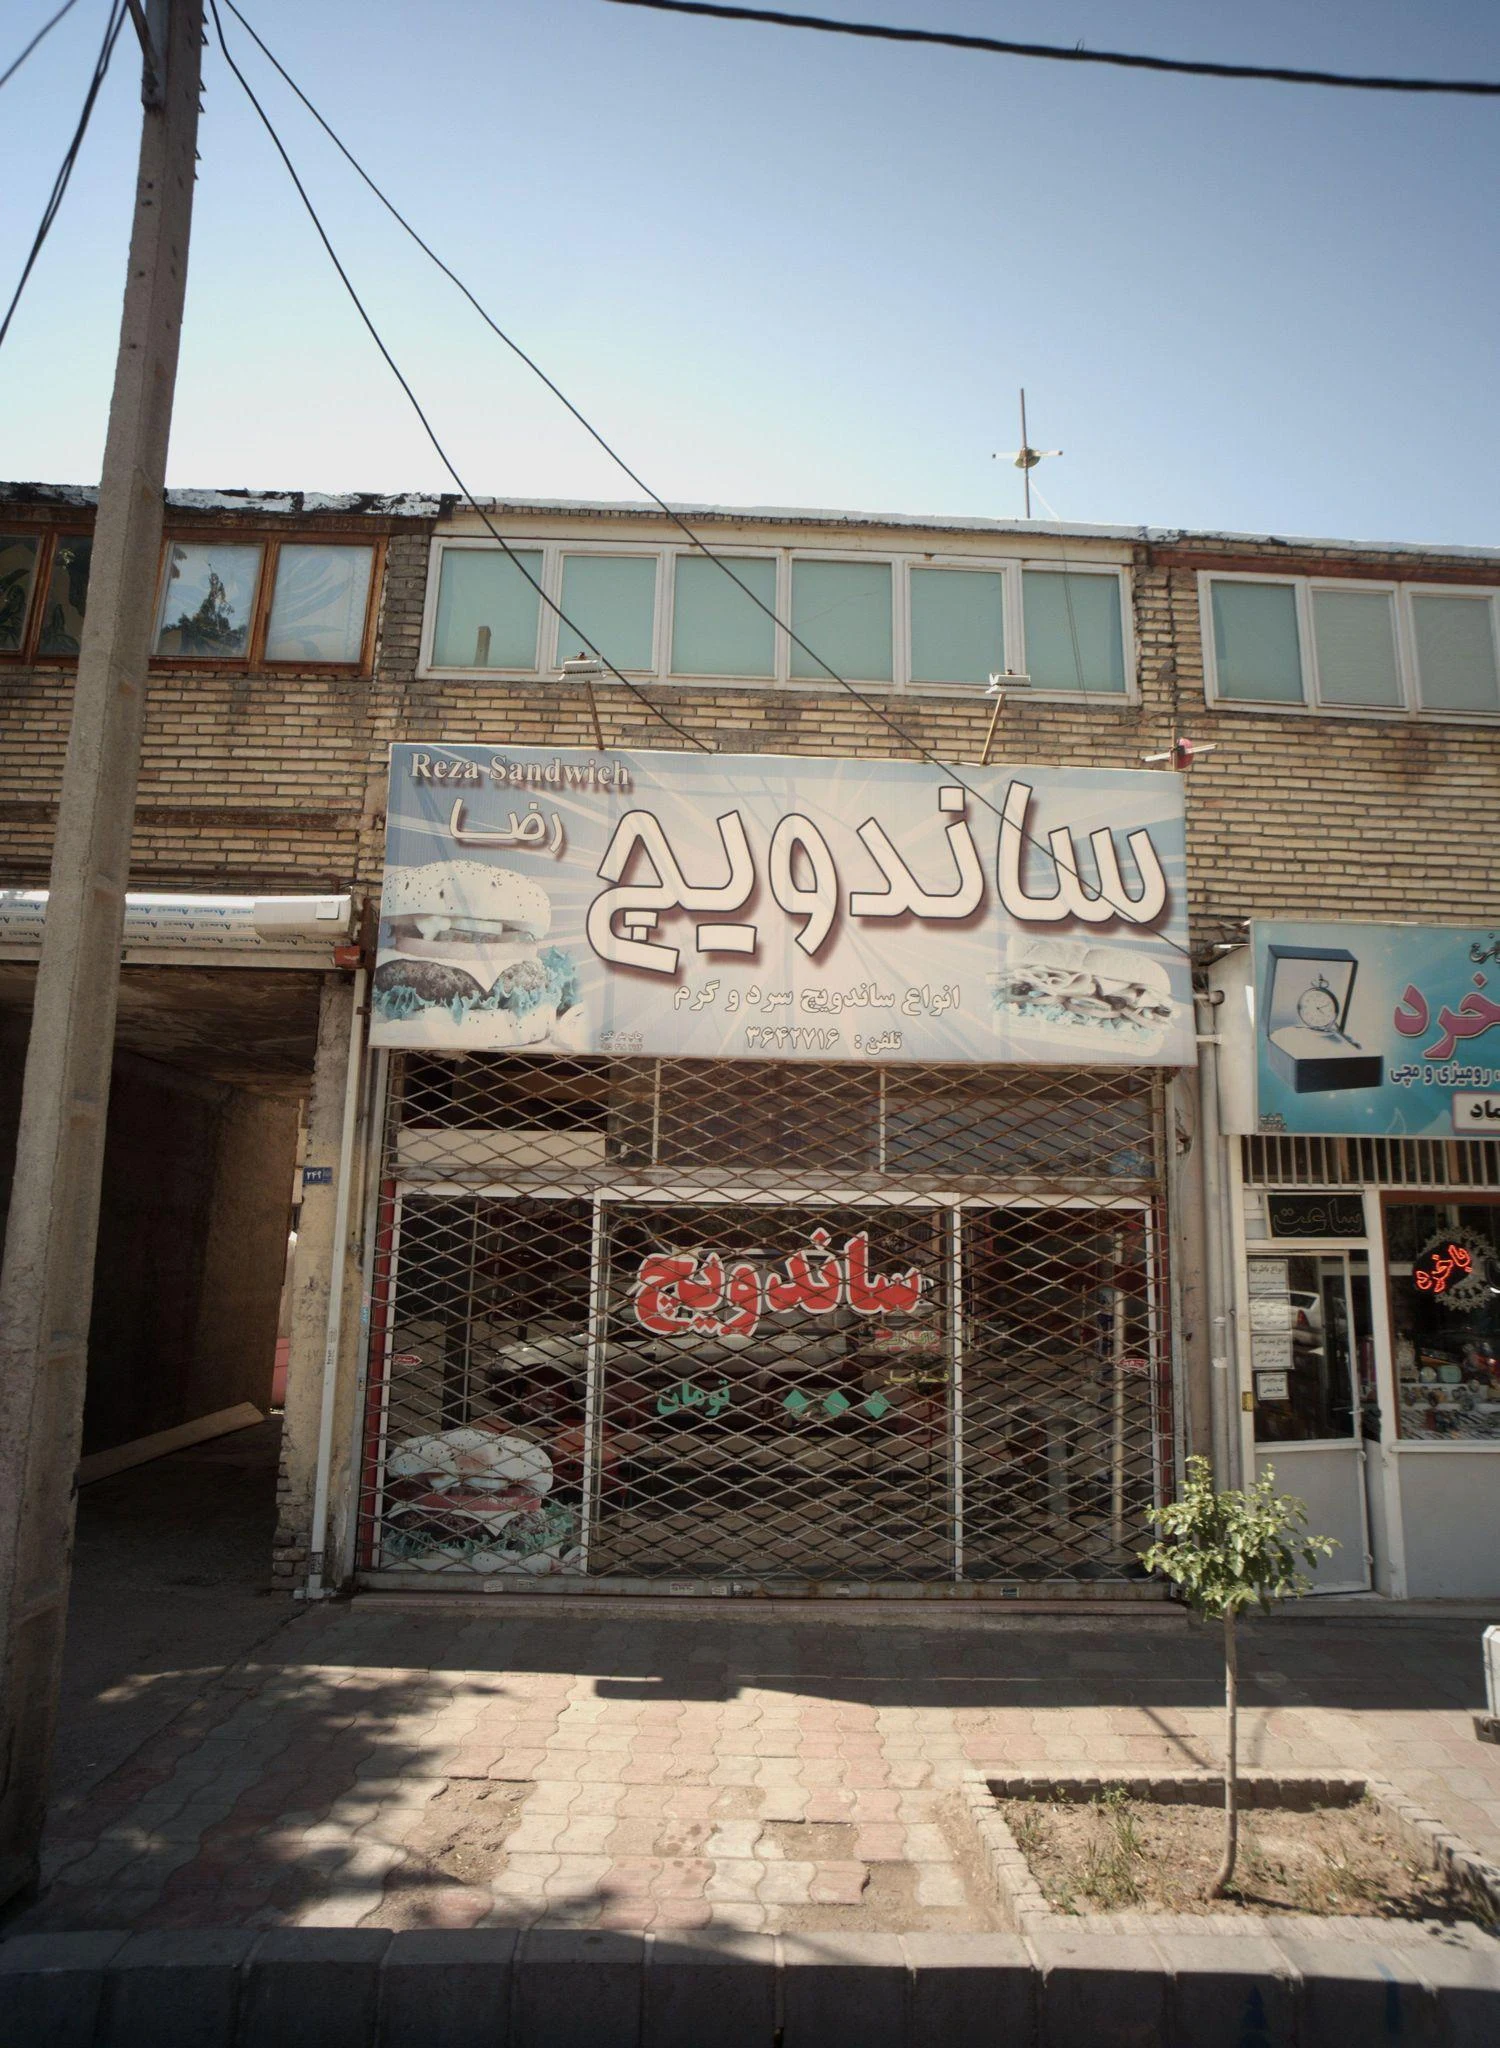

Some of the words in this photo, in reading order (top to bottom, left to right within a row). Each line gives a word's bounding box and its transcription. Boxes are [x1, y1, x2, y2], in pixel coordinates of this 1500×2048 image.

[409, 752, 479, 779] Reza
[489, 755, 630, 786] Sandwich
[450, 797, 563, 853] رضا
[586, 780, 1167, 975] ساندویچ
[673, 979, 720, 1010] گرم
[724, 989, 740, 1011] و
[746, 985, 793, 1012] سرد
[800, 982, 895, 1014] ساندویچ
[900, 984, 960, 1016] انواع
[745, 1026, 840, 1050] ۳۶۴۲۷۱۶
[1388, 1064, 1420, 1088] مچی
[1424, 1065, 1434, 1085] و
[1436, 1061, 1492, 1086] رومیزی
[1273, 1198, 1363, 1235] ساعت
[634, 1227, 922, 1337] ساندویچ
[657, 1379, 730, 1416] تومان
